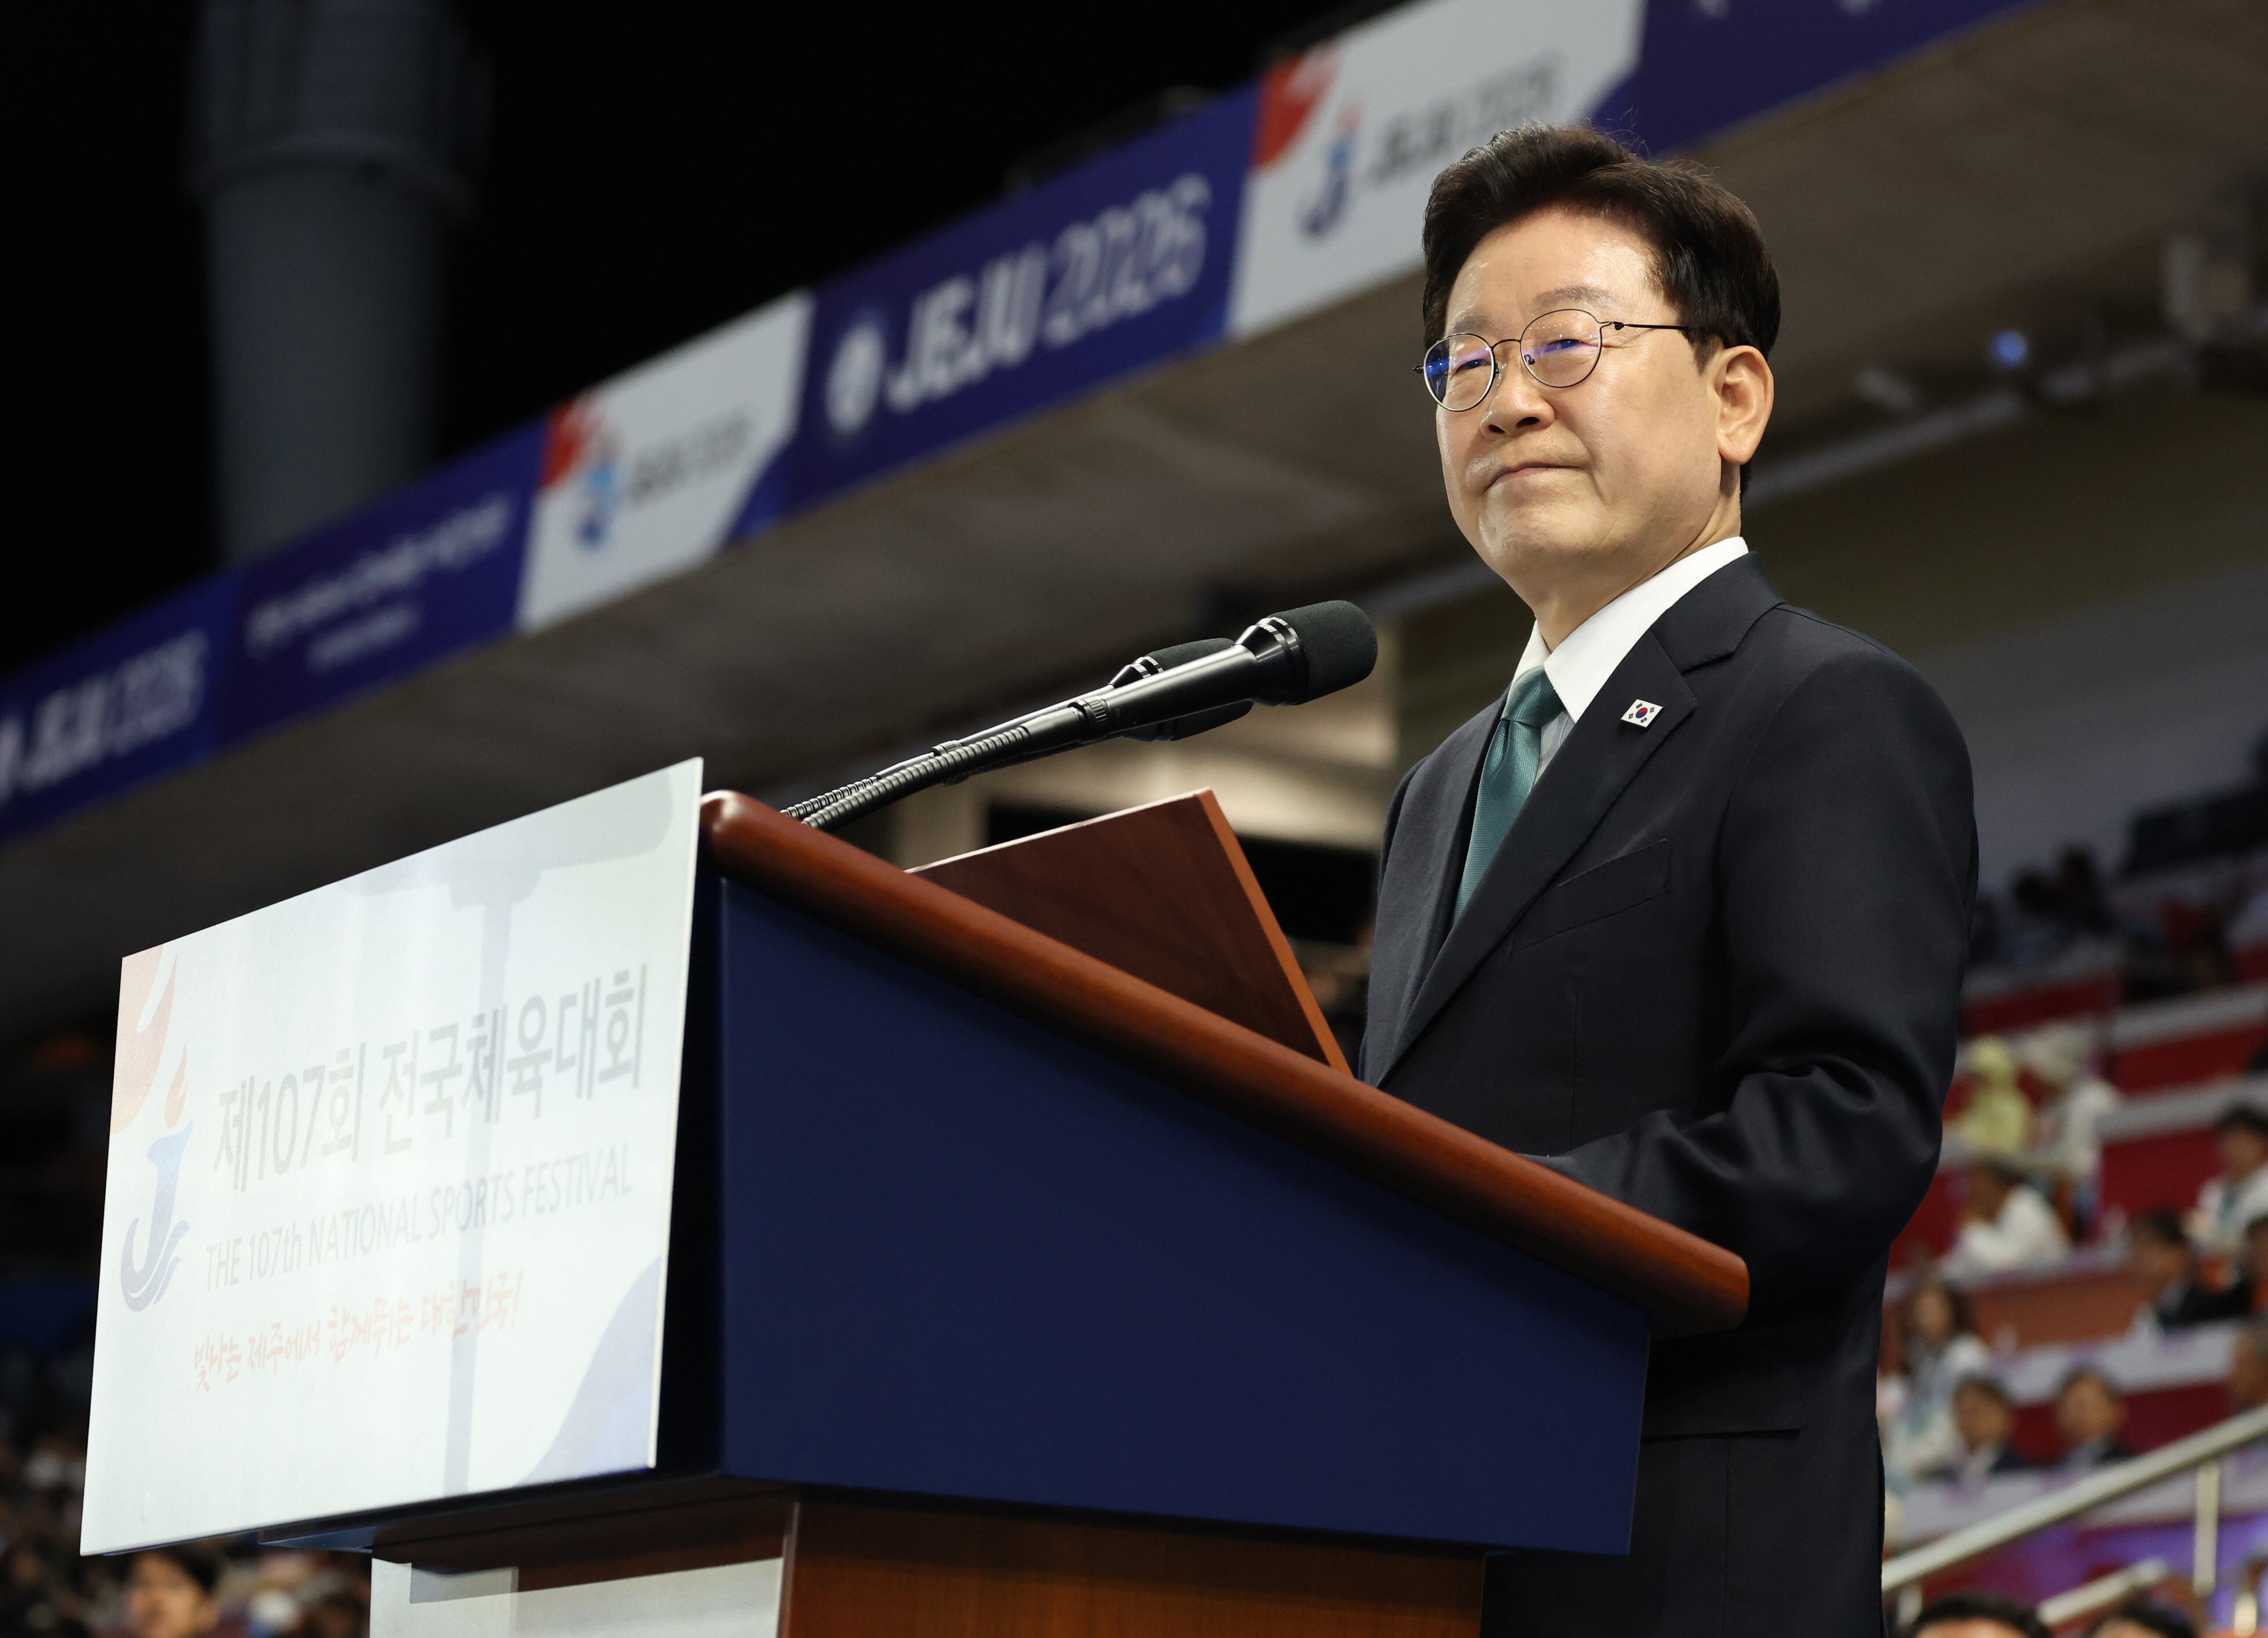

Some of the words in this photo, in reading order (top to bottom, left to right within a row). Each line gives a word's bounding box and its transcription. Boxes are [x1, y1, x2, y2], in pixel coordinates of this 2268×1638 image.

[884, 243, 1048, 412] JEJU
[213, 1042, 367, 1192] 제107회
[378, 963, 648, 1156] 전국체육대회
[206, 1239, 242, 1291] THE
[248, 1221, 302, 1284] 107th
[308, 1193, 422, 1266] NATIONAL
[428, 1170, 515, 1240] SPORTS
[521, 1143, 632, 1218] FESTIVAL
[194, 1332, 242, 1393] 빛나는
[247, 1321, 321, 1375] 제주에서
[328, 1296, 413, 1364] 함께뛰는
[420, 1270, 524, 1340] 대한민국!
